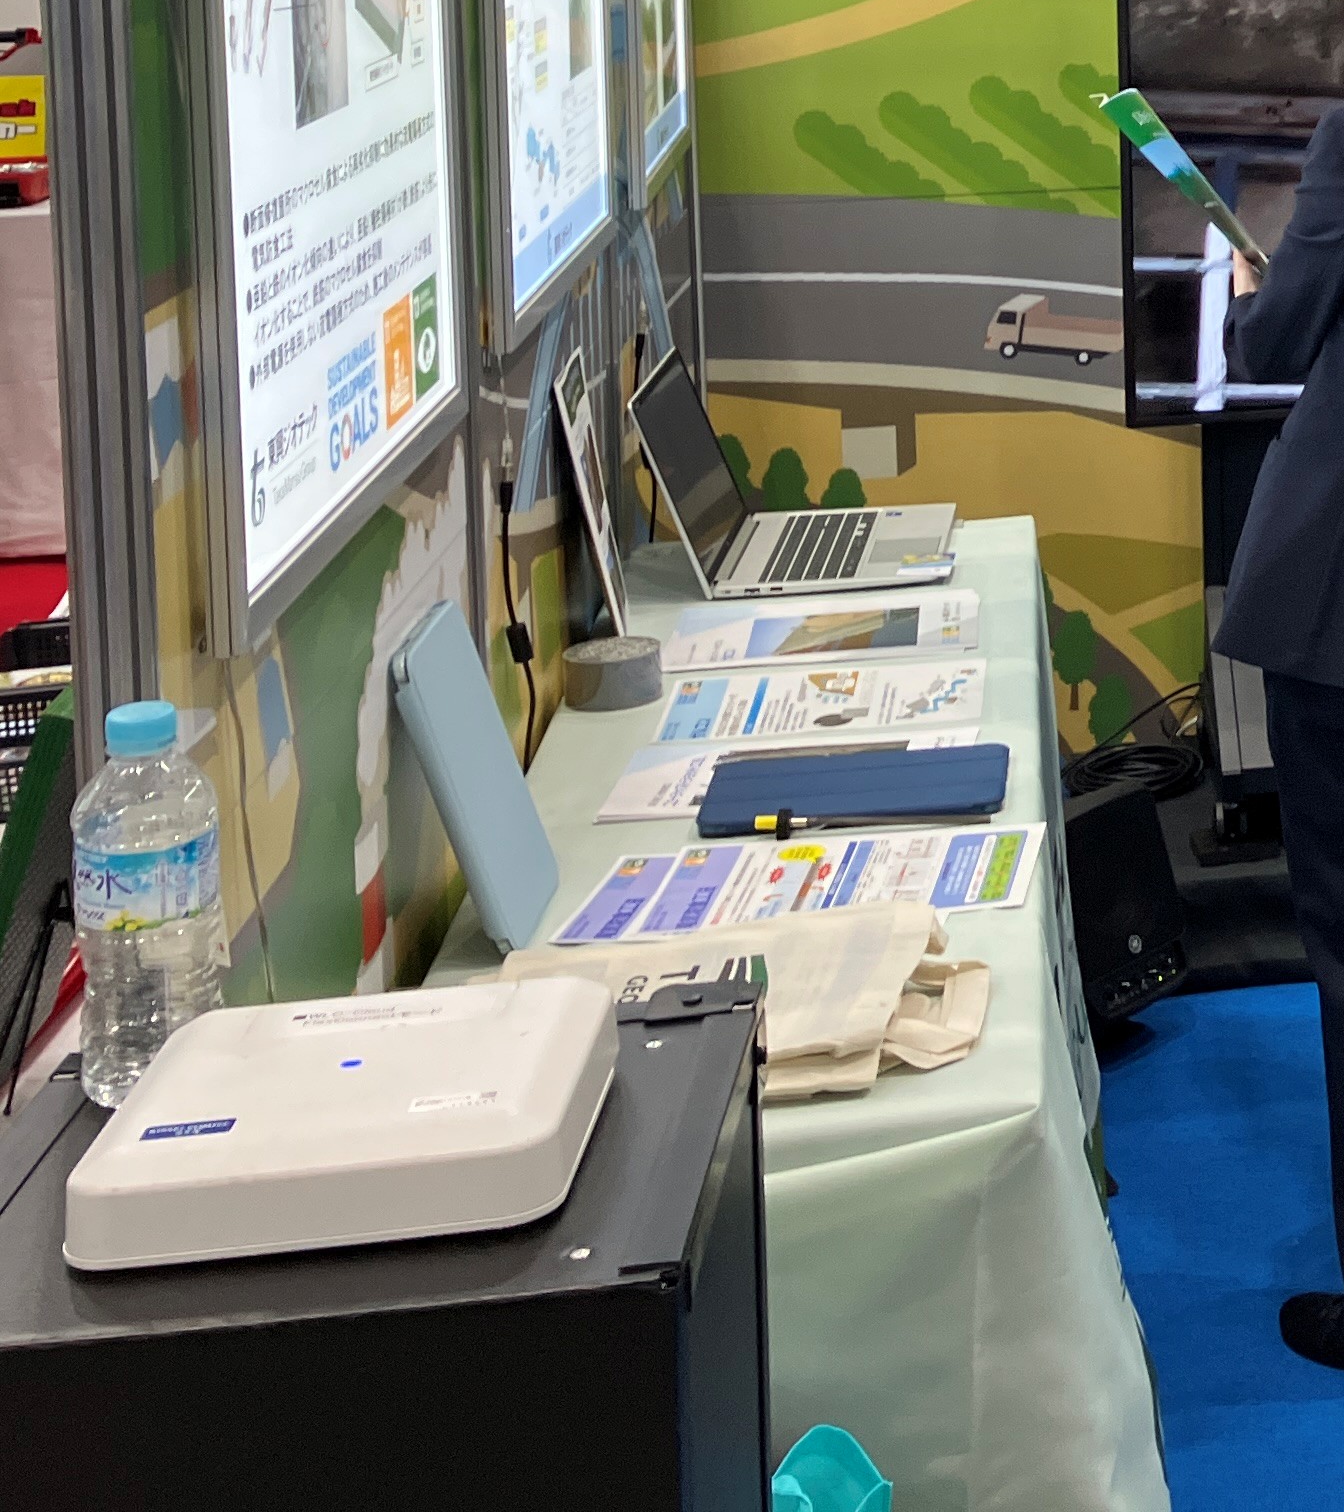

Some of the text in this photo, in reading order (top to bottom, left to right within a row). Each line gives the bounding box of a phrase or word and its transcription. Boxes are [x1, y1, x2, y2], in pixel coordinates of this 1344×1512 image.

[326, 331, 376, 392] SUSTAINABLE
[327, 358, 376, 419] DEVELOPMENT
[267, 399, 318, 471] 東興ジオテック
[329, 385, 379, 472] GOALS
